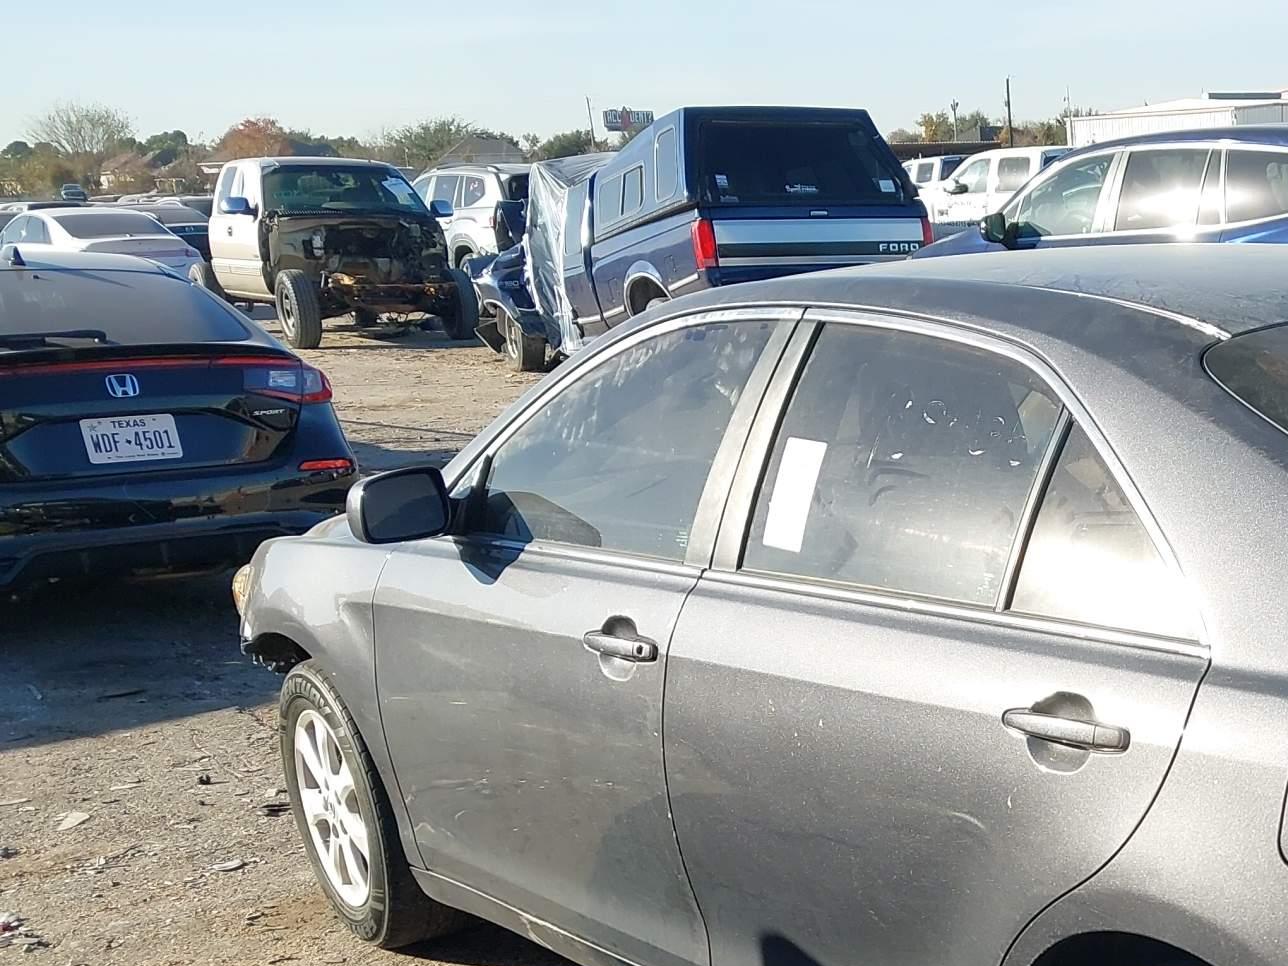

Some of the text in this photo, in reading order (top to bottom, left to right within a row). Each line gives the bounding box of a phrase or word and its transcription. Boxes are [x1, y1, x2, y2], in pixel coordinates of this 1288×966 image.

[879, 243, 919, 252] FORD
[252, 408, 286, 416] SPORT
[110, 419, 146, 429] TEXAS
[90, 429, 176, 454] WDF 4501
